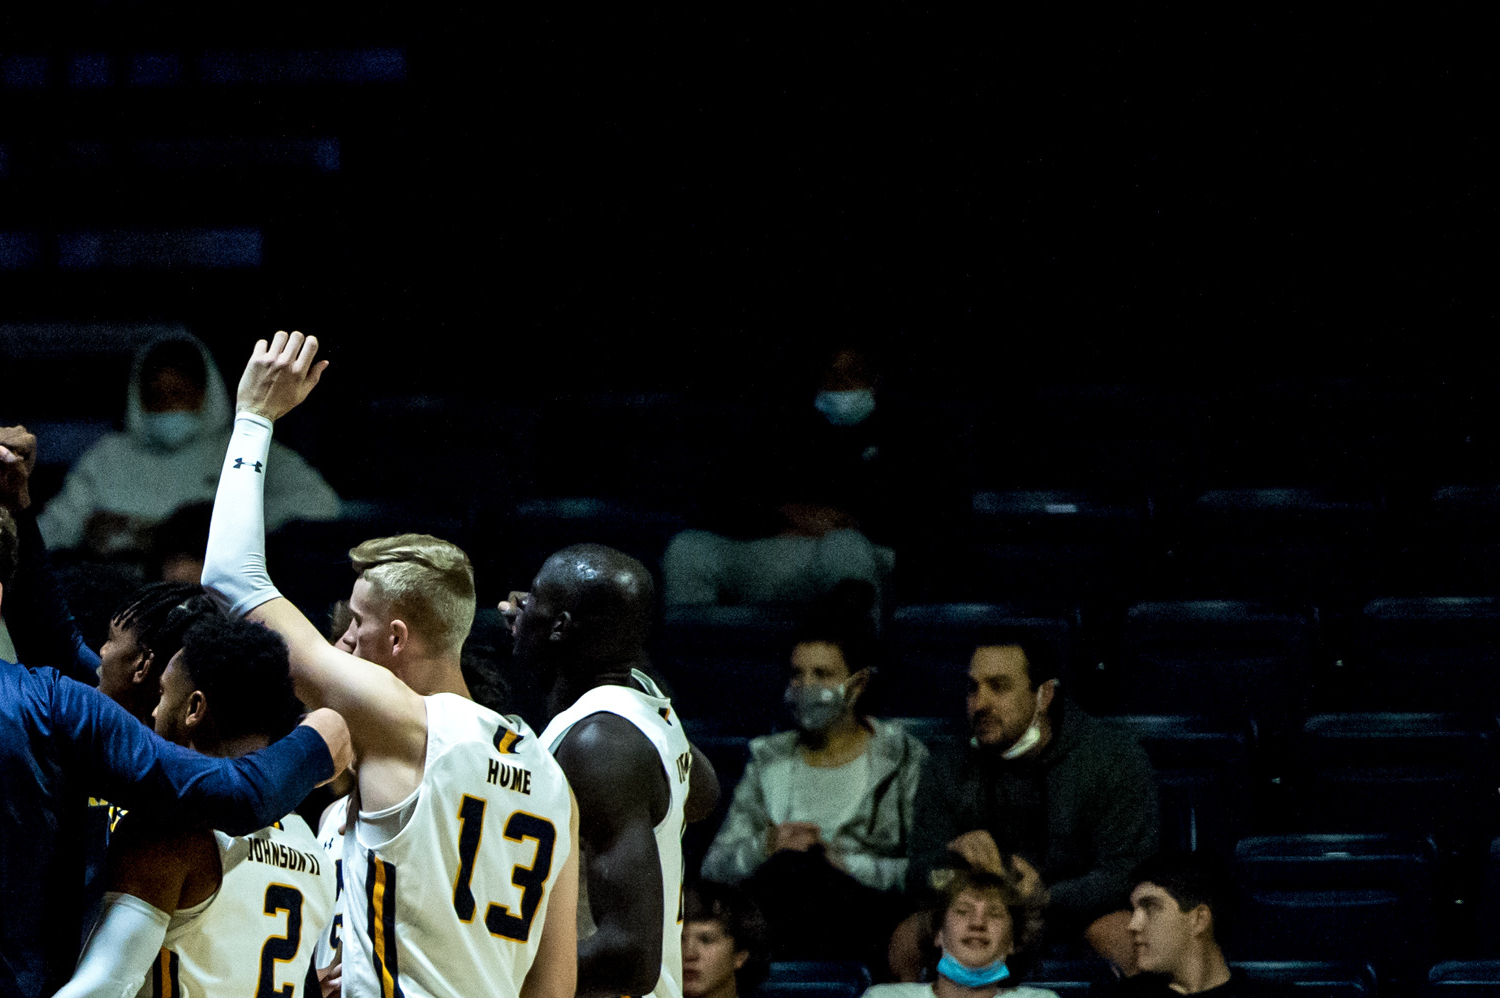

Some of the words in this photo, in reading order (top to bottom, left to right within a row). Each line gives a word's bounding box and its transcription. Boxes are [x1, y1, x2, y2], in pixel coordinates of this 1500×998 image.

[487, 758, 531, 795] HUME
[247, 838, 306, 872] JOHNSON
[453, 793, 556, 943] 13
